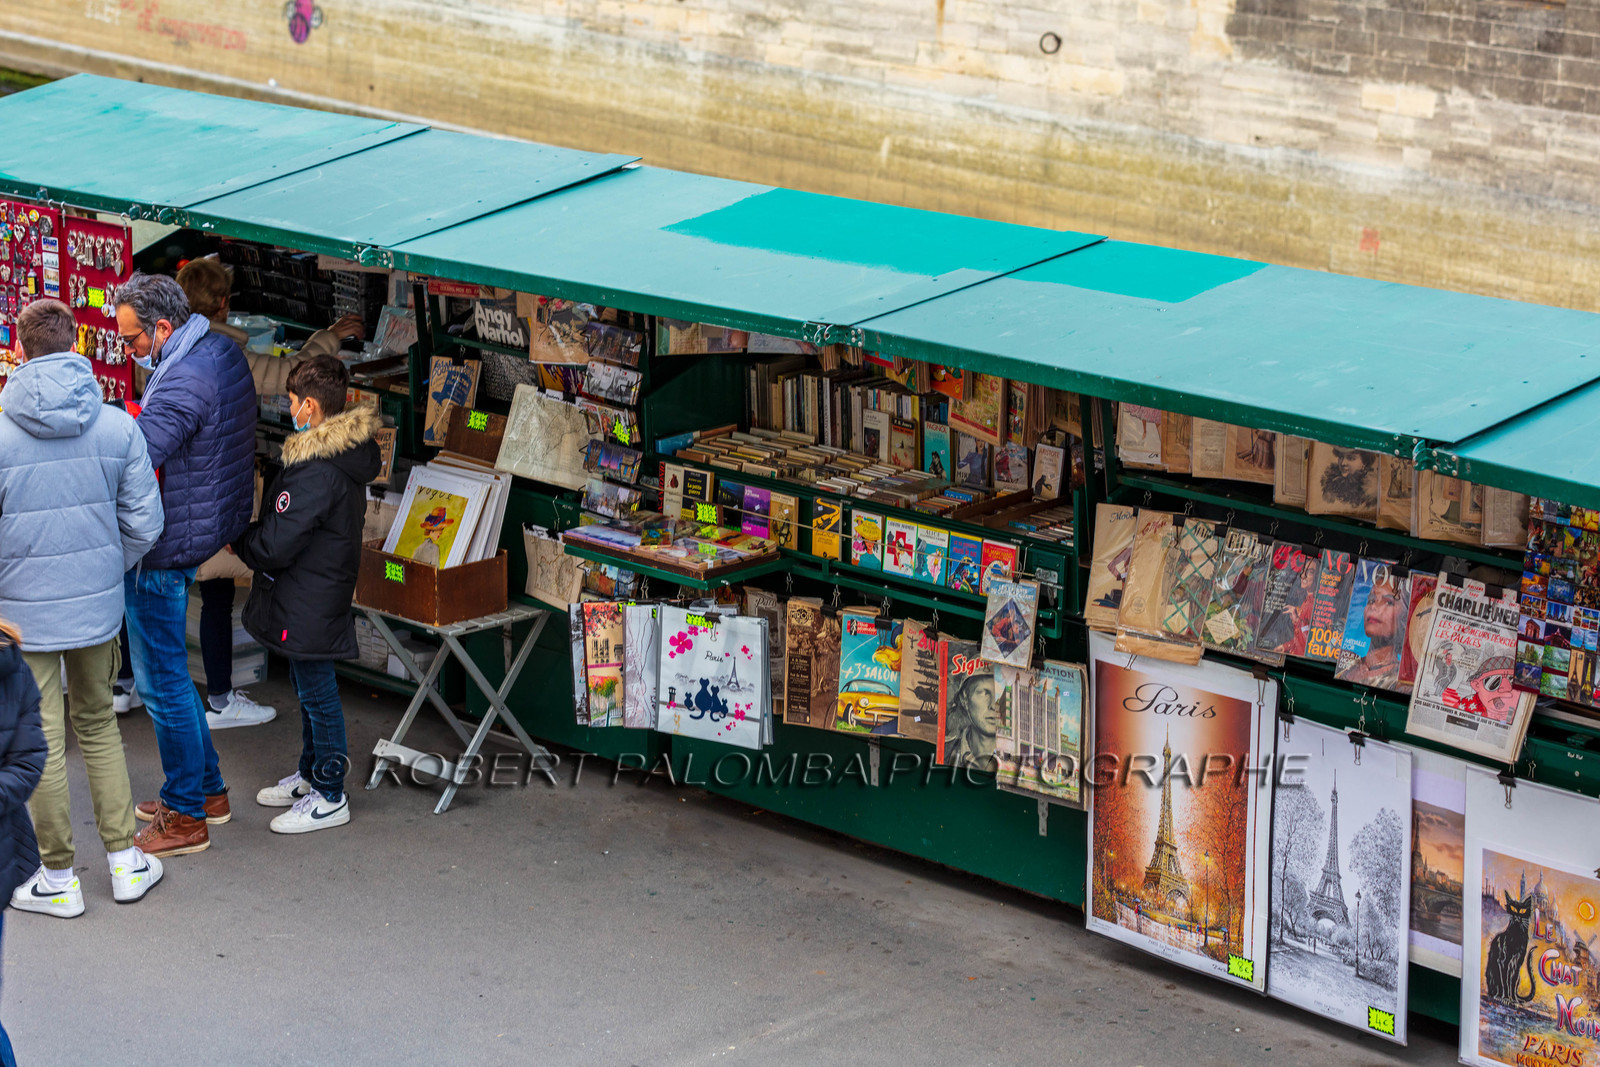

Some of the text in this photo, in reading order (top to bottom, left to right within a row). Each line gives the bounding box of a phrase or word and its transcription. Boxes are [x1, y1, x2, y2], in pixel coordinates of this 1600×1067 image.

[474, 301, 512, 330] Andy
[475, 319, 525, 347] Warhol
[926, 422, 948, 434] PAGNOL
[1438, 592, 1491, 620] CHARLIE
[1494, 606, 1520, 626] HEB
[1438, 620, 1452, 630] LES
[1310, 628, 1343, 646] 100%
[1435, 629, 1481, 648] LES PALACES
[705, 650, 724, 662] Paris
[1308, 642, 1340, 659] fauve
[864, 666, 898, 682] SALON
[952, 654, 992, 676] Sign
[1122, 682, 1218, 720] Paris
[1533, 907, 1556, 943] LE
[1538, 949, 1582, 987] CHAT
[1524, 1034, 1584, 1066] PARIS
